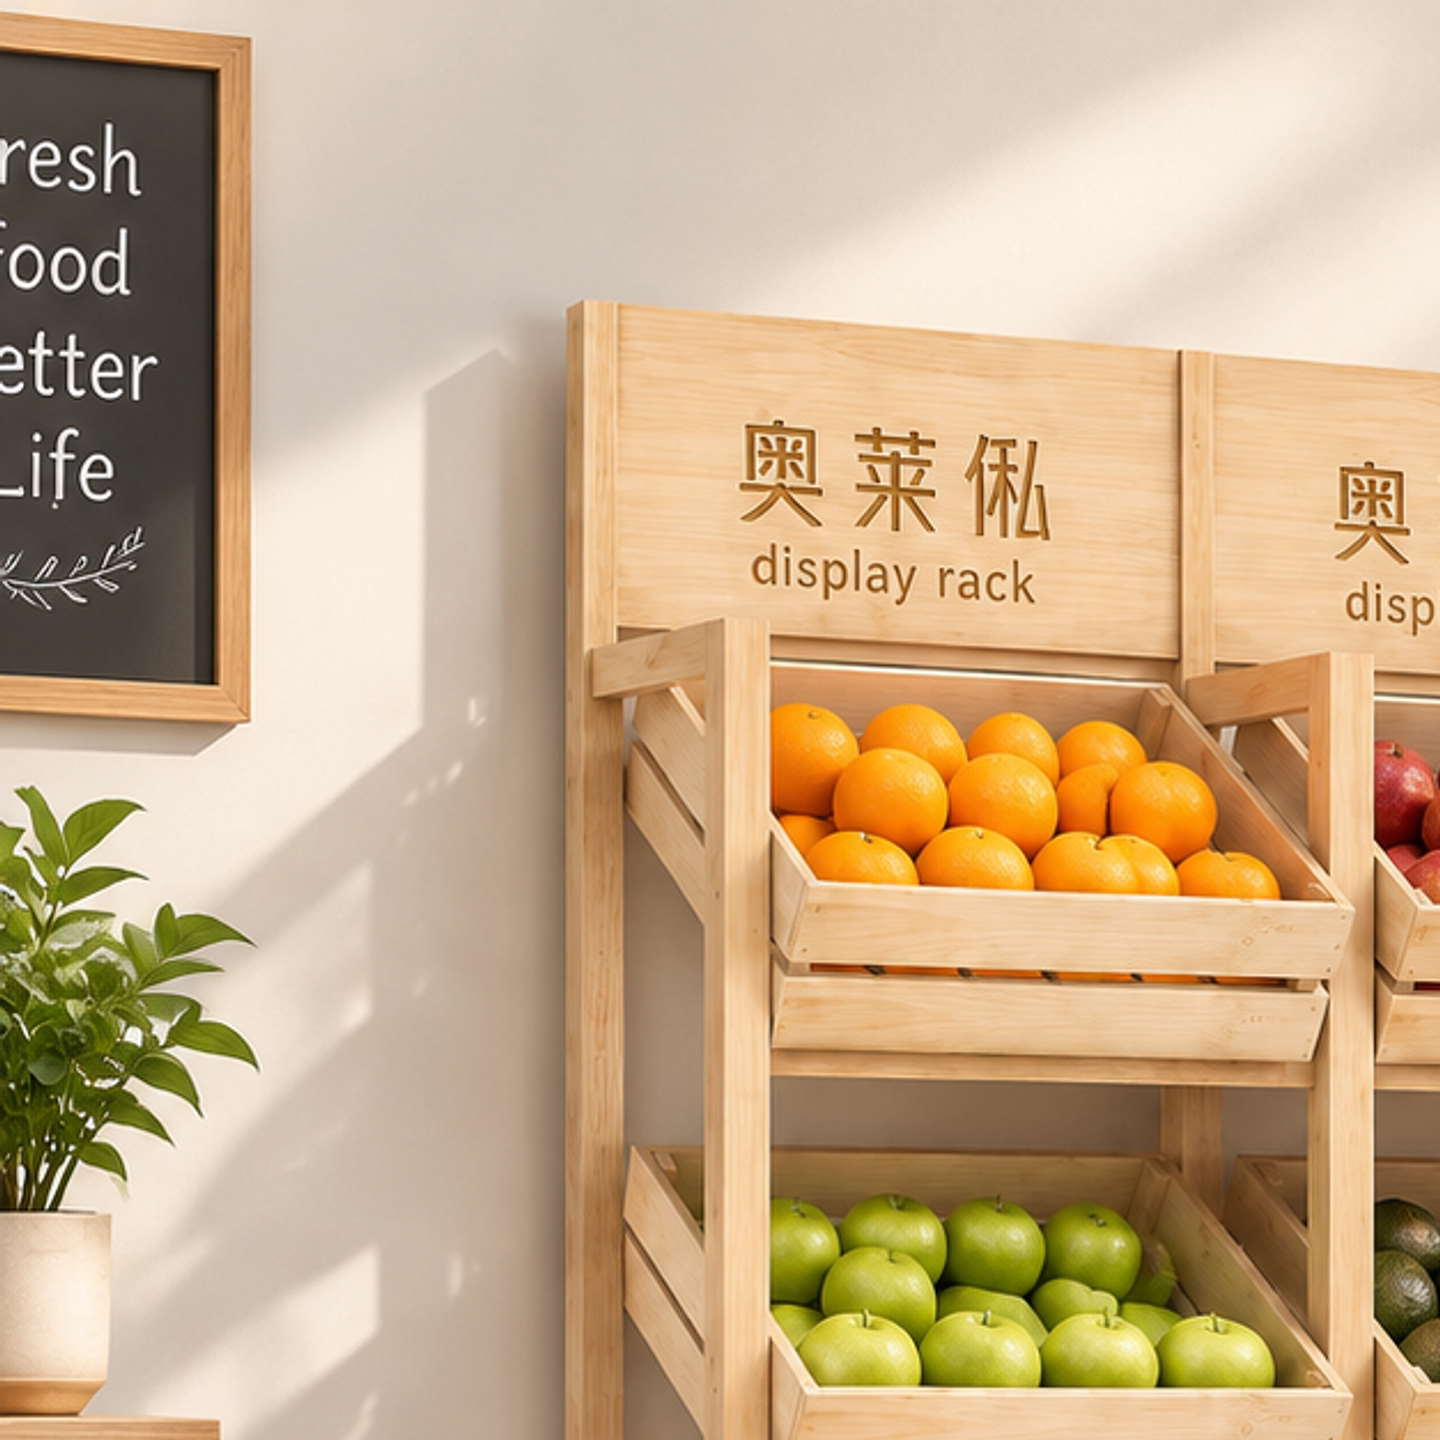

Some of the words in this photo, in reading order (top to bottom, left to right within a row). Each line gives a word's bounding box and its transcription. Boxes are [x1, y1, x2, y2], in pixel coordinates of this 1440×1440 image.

[0, 220, 131, 296] ood
[0, 330, 158, 401] etter
[751, 542, 917, 606] display
[938, 559, 1036, 604] rack
